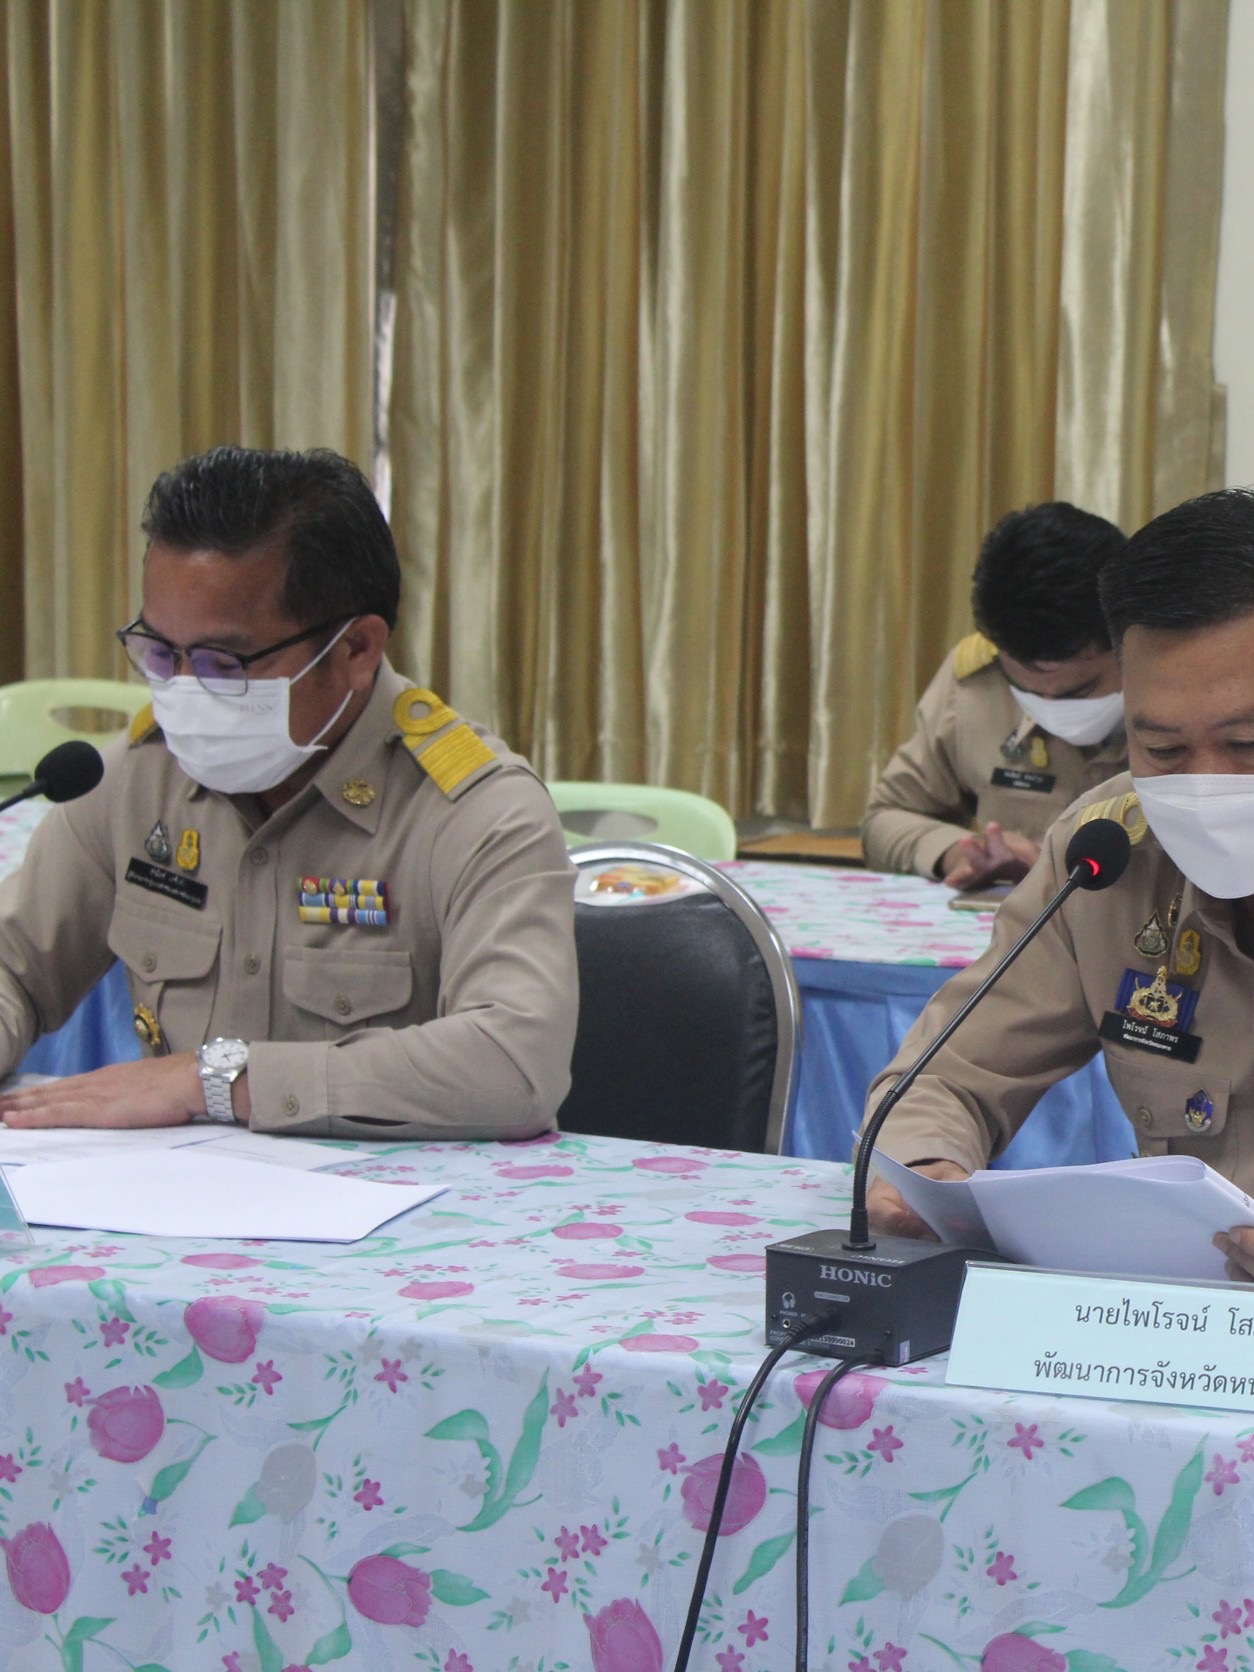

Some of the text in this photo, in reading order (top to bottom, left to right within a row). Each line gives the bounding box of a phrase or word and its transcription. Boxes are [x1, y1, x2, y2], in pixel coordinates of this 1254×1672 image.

[820, 1264, 892, 1288] HONiC
[1075, 1297, 1211, 1333] นายไพโรจน์
